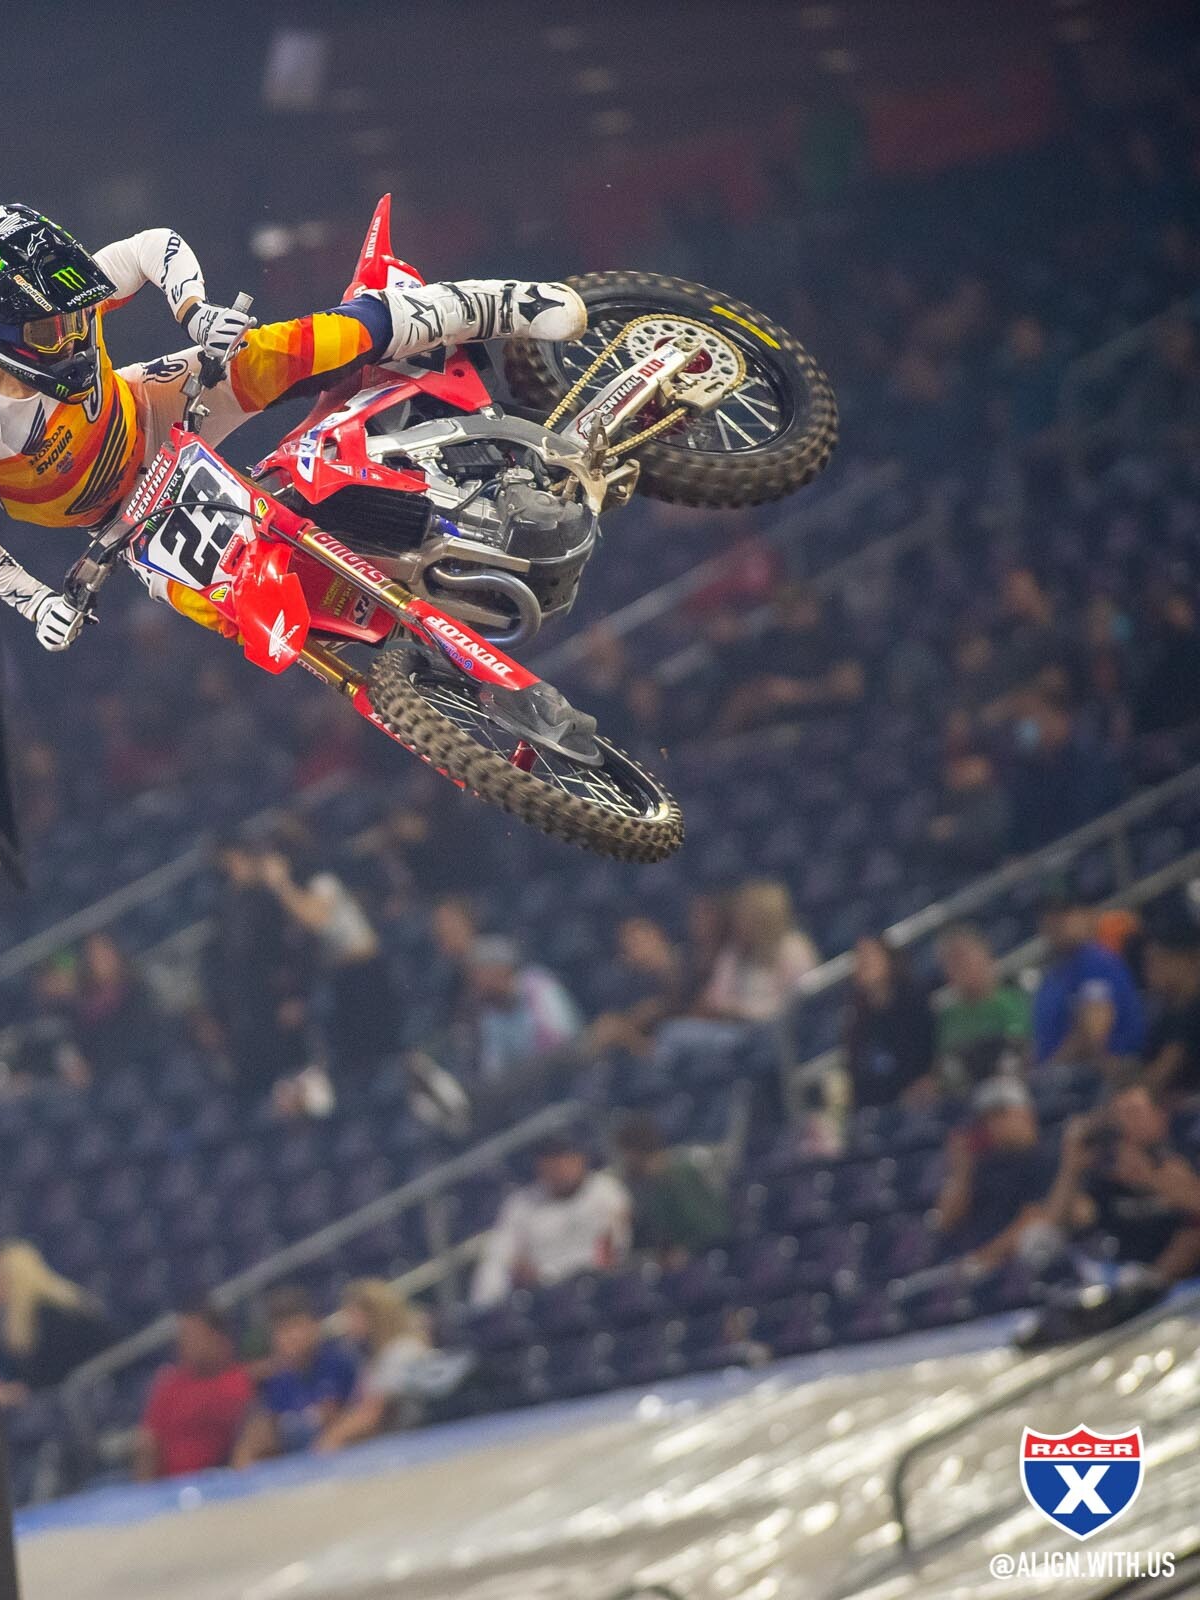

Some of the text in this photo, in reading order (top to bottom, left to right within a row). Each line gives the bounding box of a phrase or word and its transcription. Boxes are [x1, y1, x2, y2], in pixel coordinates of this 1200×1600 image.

[0, 219, 40, 241] HONDA
[29, 425, 65, 465] HONDA
[36, 429, 73, 475] SHOWA
[133, 458, 173, 522] RENTHAL
[220, 536, 239, 567] HONDA
[313, 532, 384, 583] SHOWA
[424, 615, 513, 676] DUNLOP
